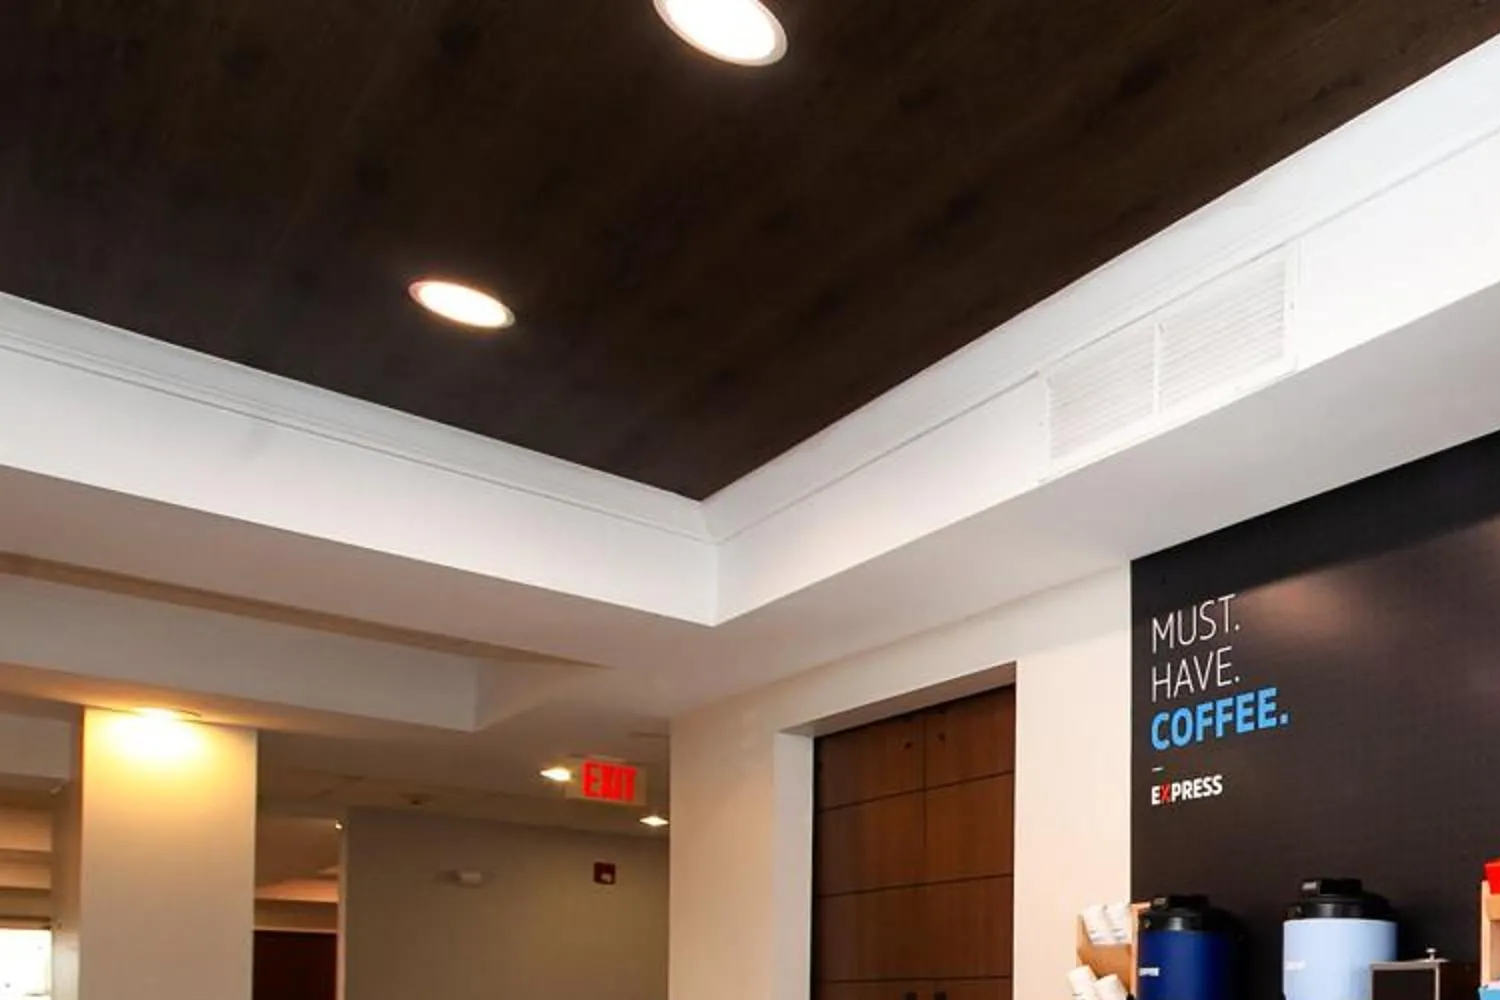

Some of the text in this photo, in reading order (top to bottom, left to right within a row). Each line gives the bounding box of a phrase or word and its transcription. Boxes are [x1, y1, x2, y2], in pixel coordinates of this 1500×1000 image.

[1152, 594, 1241, 653] MUST.
[1152, 646, 1240, 702] HAVE.
[1151, 688, 1288, 750] COFFEE.
[583, 761, 637, 802] EXIT
[1152, 775, 1223, 805] EXPRESS
